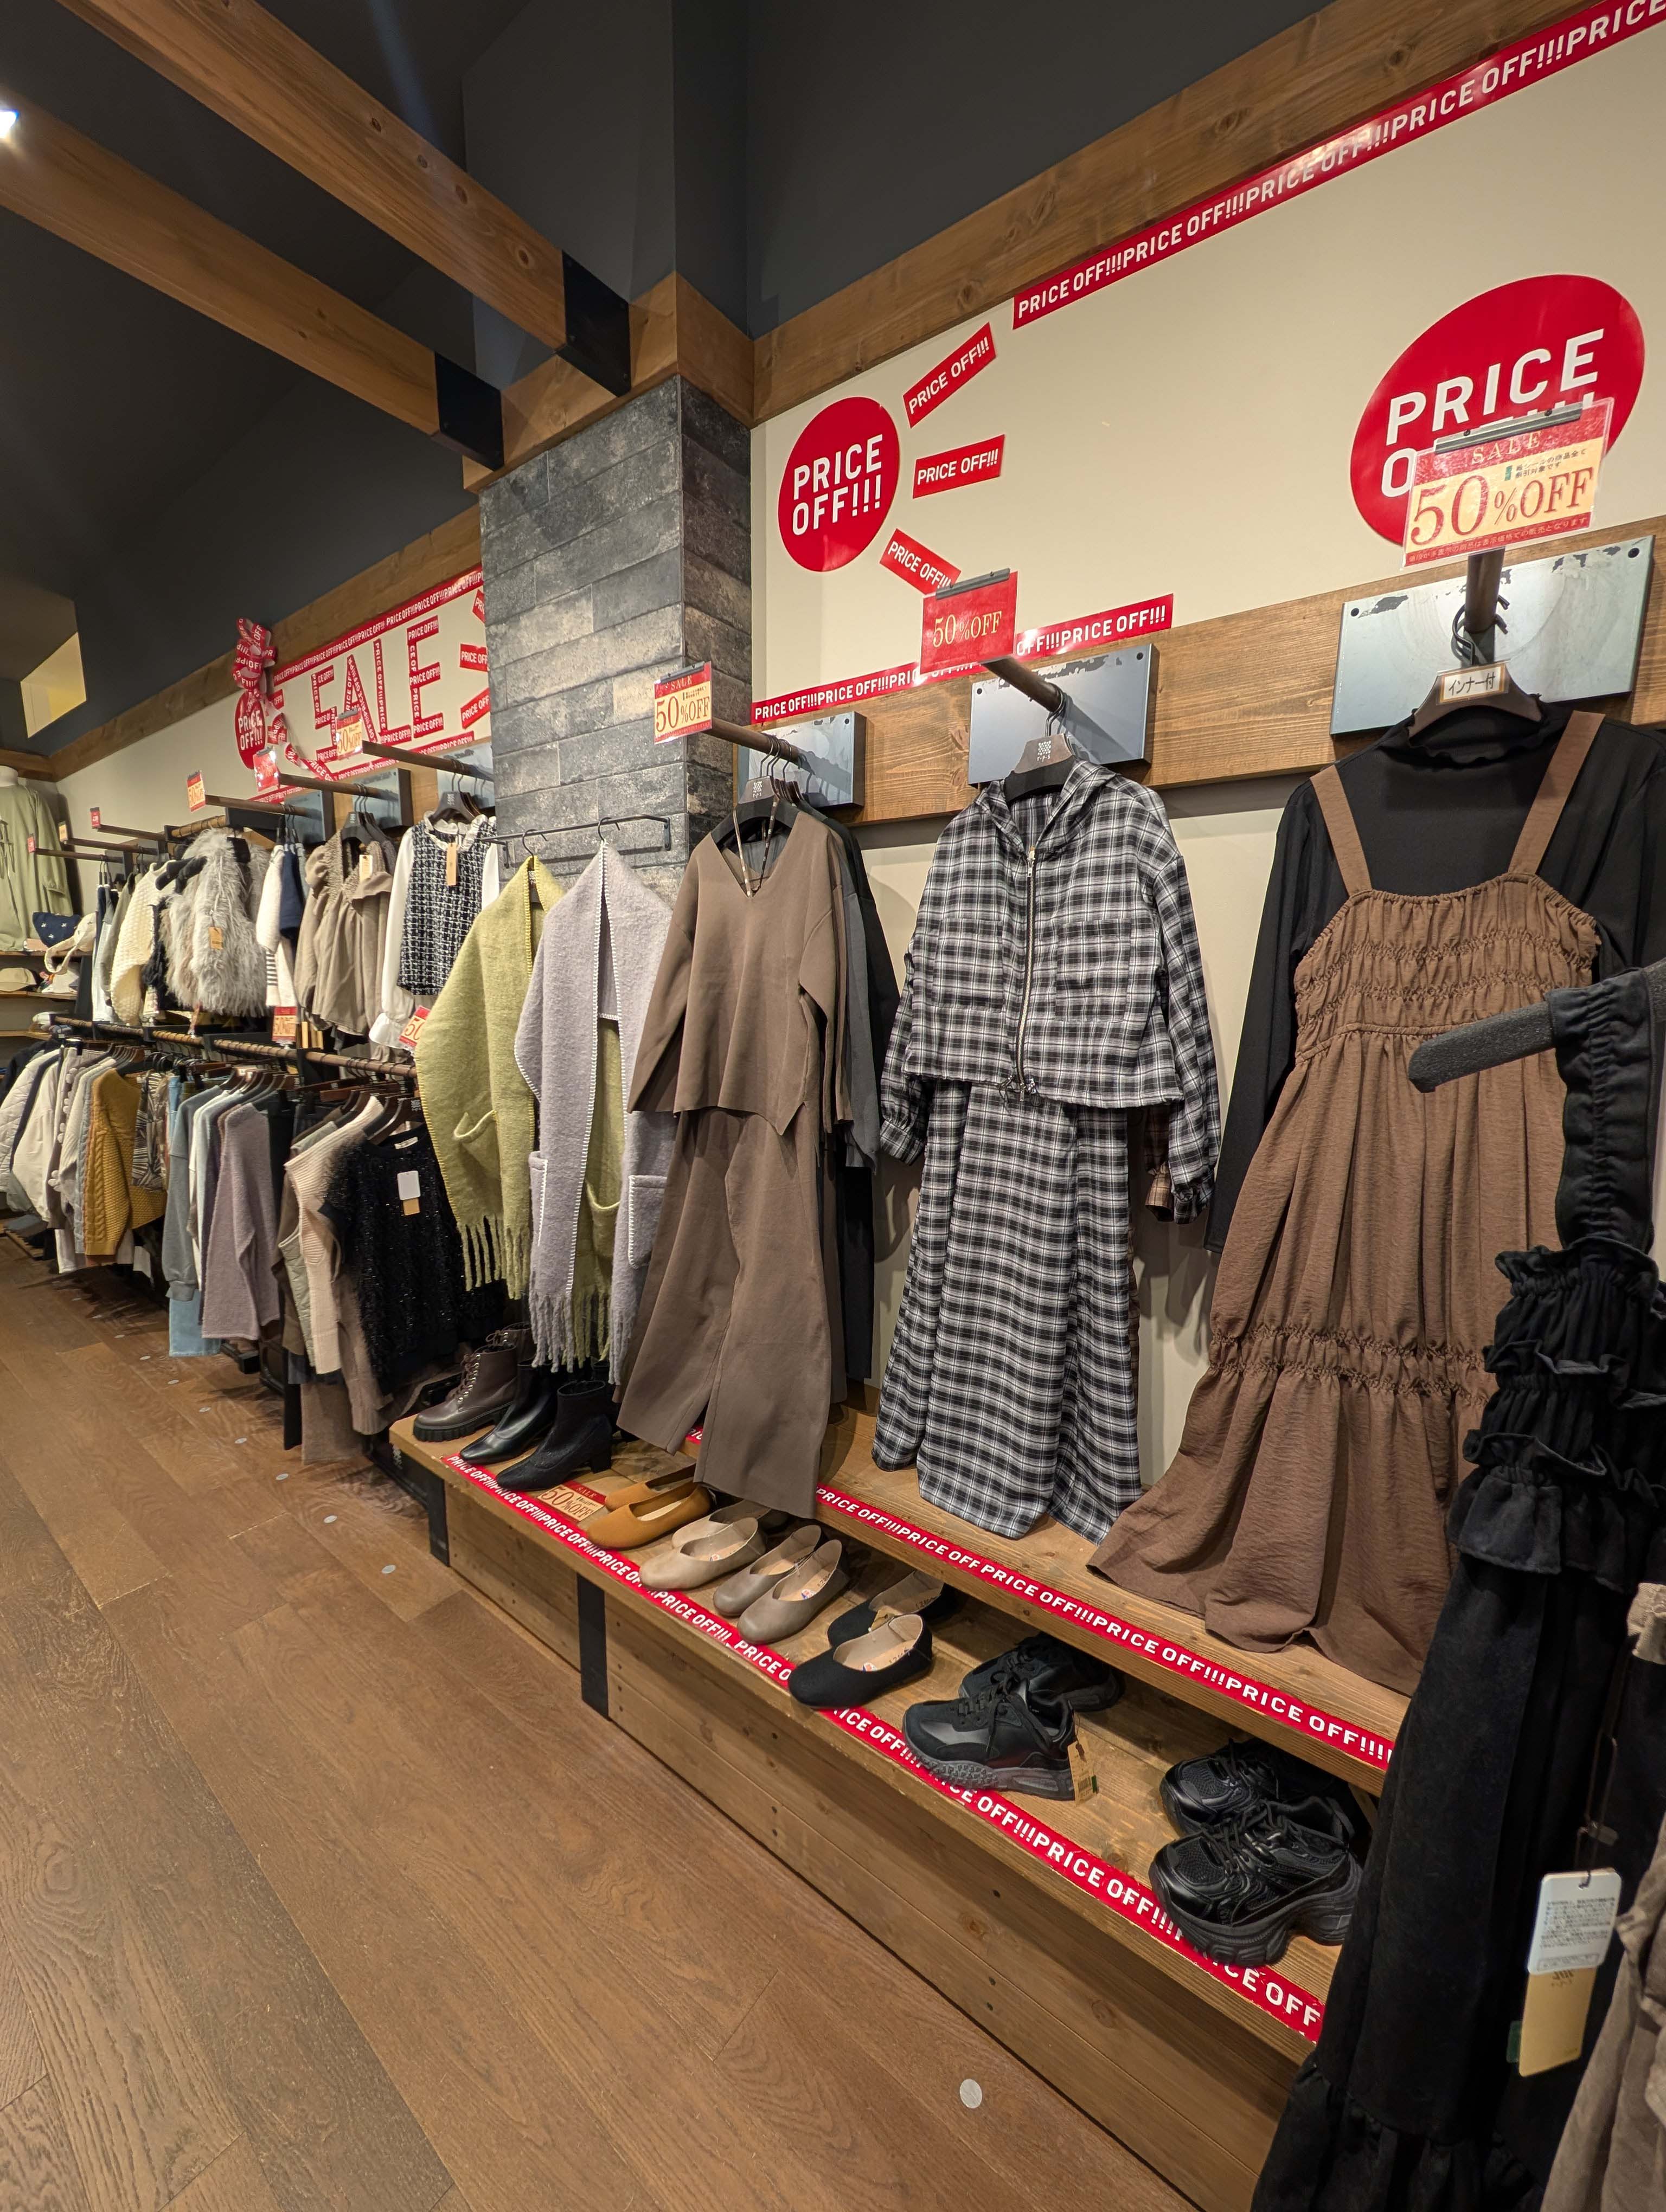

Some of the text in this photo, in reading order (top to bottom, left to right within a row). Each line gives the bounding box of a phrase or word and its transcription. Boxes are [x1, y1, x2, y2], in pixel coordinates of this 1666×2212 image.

[1018, 279, 1069, 319] PRICE
[908, 337, 990, 415] PRICE OFF!!!
[1385, 329, 1605, 446] PRICE
[1472, 430, 1542, 465] SALE
[794, 435, 883, 500] PRICE
[917, 448, 998, 486] PRICE OFF!!!
[792, 474, 882, 536] OFF!!!
[1411, 467, 1593, 546] 50%OFF
[887, 542, 921, 573] PRICE
[387, 612, 402, 626] PRICE
[408, 619, 438, 640] PRICE OFF!!!
[933, 610, 1002, 648] 50%OFF
[1117, 605, 1166, 633] OFF!!!
[461, 651, 477, 663] PRICE
[409, 672, 426, 686] PRICE
[670, 675, 693, 691] SALE
[1448, 672, 1496, 696] インナー付
[238, 710, 263, 734] PRICE
[462, 703, 478, 722] PRICE
[656, 696, 710, 732] 50%OFF
[755, 701, 786, 720] PRICE
[240, 727, 263, 751] OFF!!!
[414, 721, 429, 734] PRICE
[447, 1455, 477, 1474] PRICE
[541, 1486, 594, 1519] 50%OFF
[575, 1486, 597, 1498] SALE
[981, 1564, 1039, 1597] PRICE
[692, 1614, 732, 1642] OFF!!!
[734, 1640, 782, 1675] PRICE
